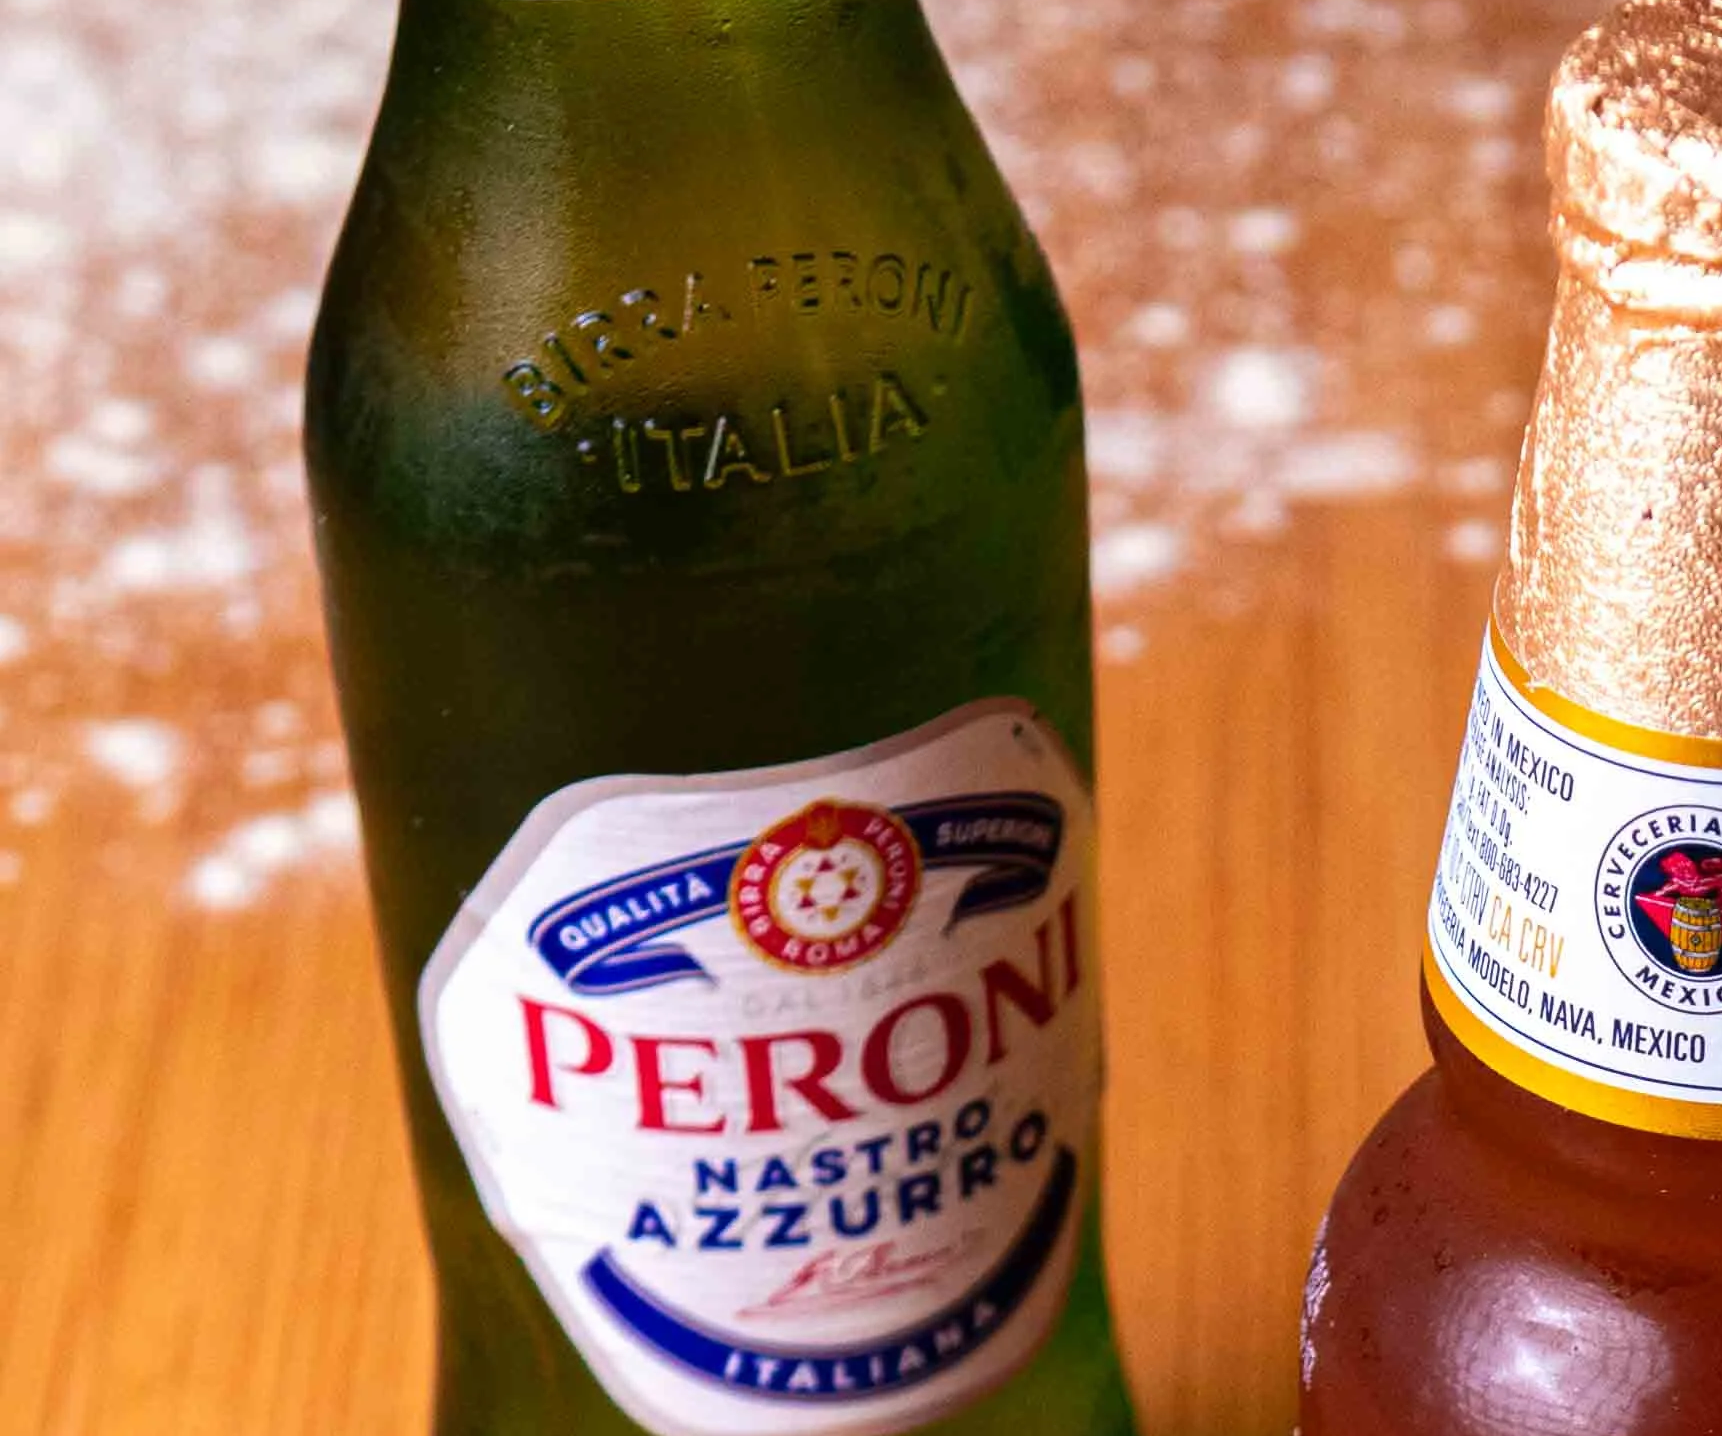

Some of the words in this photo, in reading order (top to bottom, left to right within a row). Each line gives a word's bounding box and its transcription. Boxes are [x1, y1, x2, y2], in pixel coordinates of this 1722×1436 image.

[748, 250, 975, 347] PERONI
[1506, 732, 1575, 803] MEXICO
[555, 872, 713, 955] QUALITÀ
[1479, 831, 1559, 914] 800-683-4227
[1603, 813, 1722, 940] CERVECERIA
[781, 923, 885, 966] ROMA
[1489, 894, 1513, 953] CA
[1518, 916, 1565, 979] CRV
[516, 893, 1082, 1137] PERONI
[1467, 938, 1533, 1016] MODELO,
[1539, 990, 1604, 1045] NAVA,
[1610, 1020, 1707, 1064] MEXICO
[626, 1110, 1048, 1252] AZZURRO
[693, 1095, 993, 1196] NASTRO
[722, 1300, 997, 1393] ITALIANA
